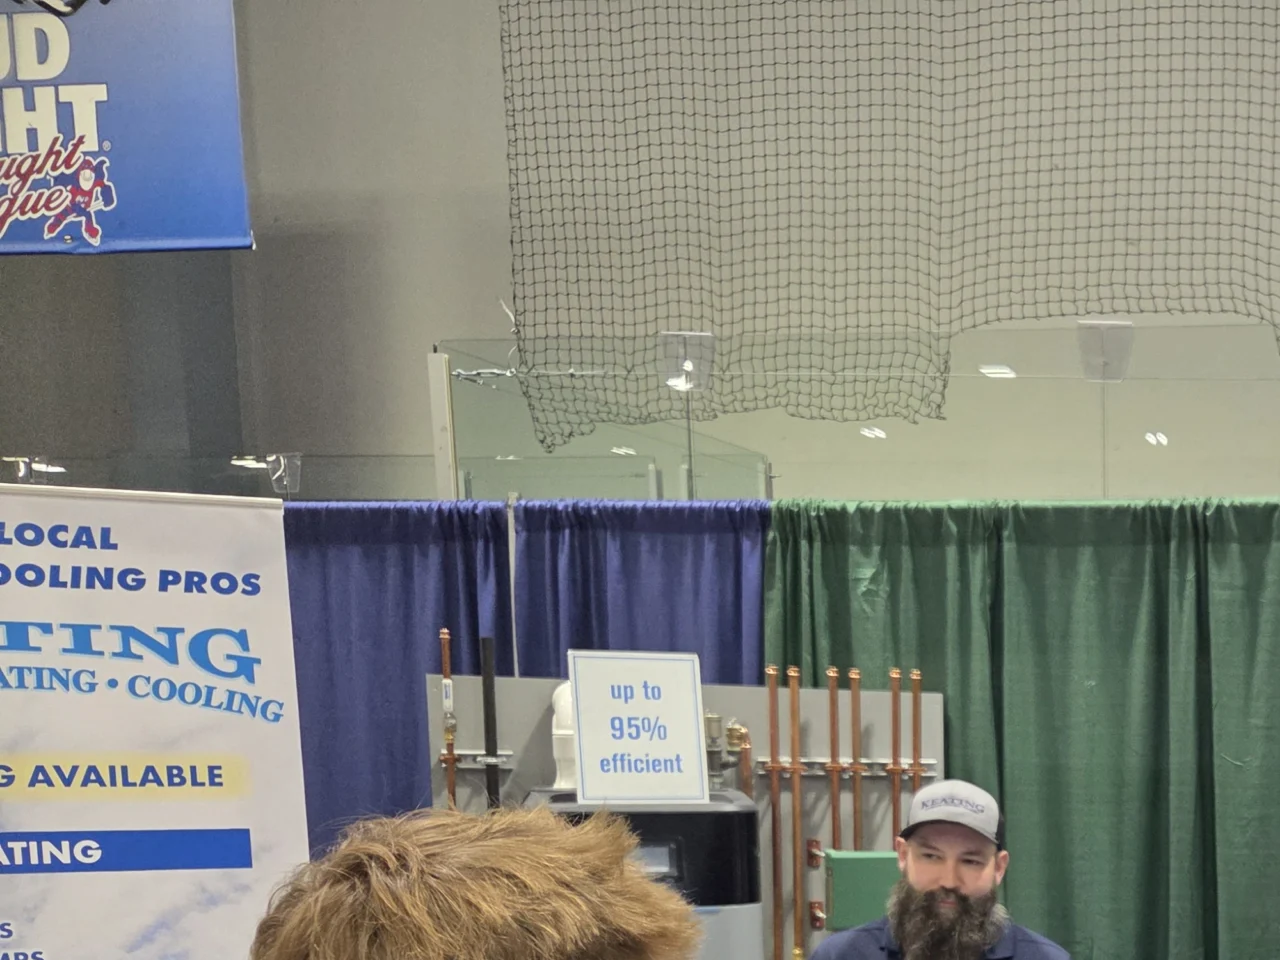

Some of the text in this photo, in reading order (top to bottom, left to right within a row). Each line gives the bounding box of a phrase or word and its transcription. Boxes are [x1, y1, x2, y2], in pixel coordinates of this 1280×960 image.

[0, 12, 70, 80] D
[0, 522, 119, 550] LOCAL
[158, 569, 261, 596] PROS
[128, 675, 285, 723] COOLING
[610, 680, 662, 704] up to
[610, 716, 668, 741] 95%
[28, 764, 224, 788] AVAILABLE
[600, 753, 684, 773] efficient
[921, 798, 985, 814] KEATING
[0, 839, 103, 867] TING
